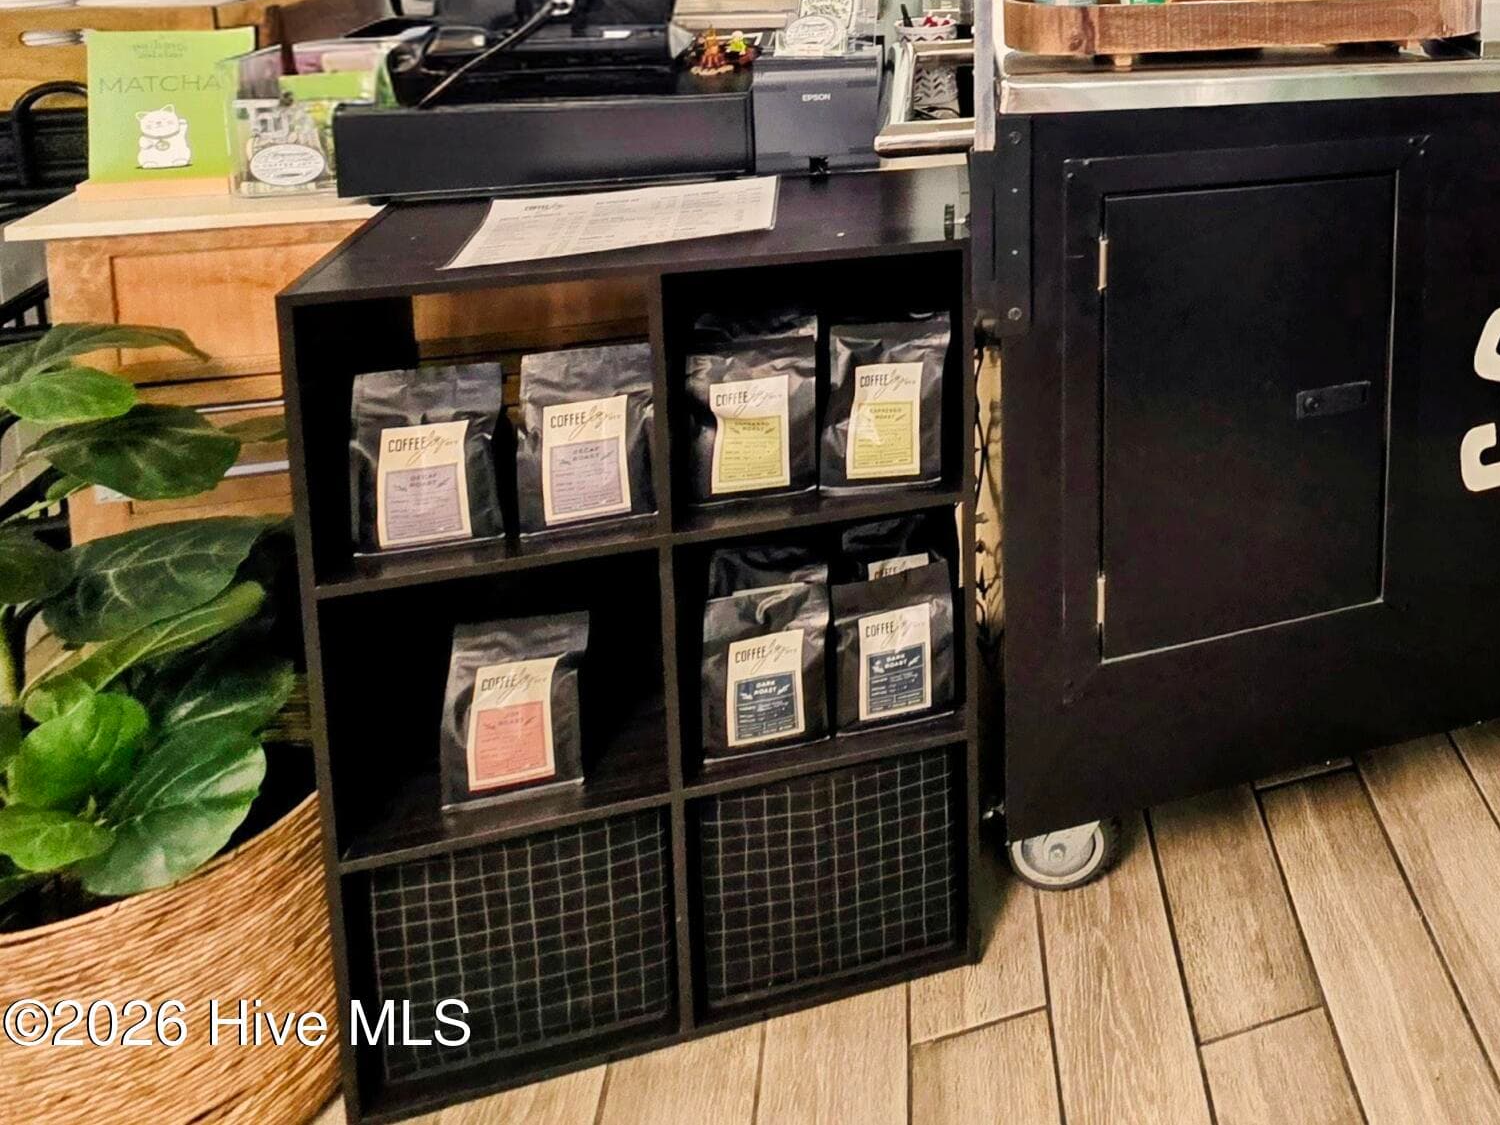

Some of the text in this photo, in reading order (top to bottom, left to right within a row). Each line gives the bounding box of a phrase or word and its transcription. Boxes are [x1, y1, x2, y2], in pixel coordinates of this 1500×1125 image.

[100, 75, 224, 94] MATCHA
[802, 93, 831, 102] EPSON
[860, 374, 889, 388] COFFEE
[716, 391, 748, 407] COFFEE
[550, 411, 587, 428] COFFEE
[388, 436, 426, 453] COFFEE
[865, 620, 895, 638] COFFEE
[735, 645, 766, 664] COFFEE
